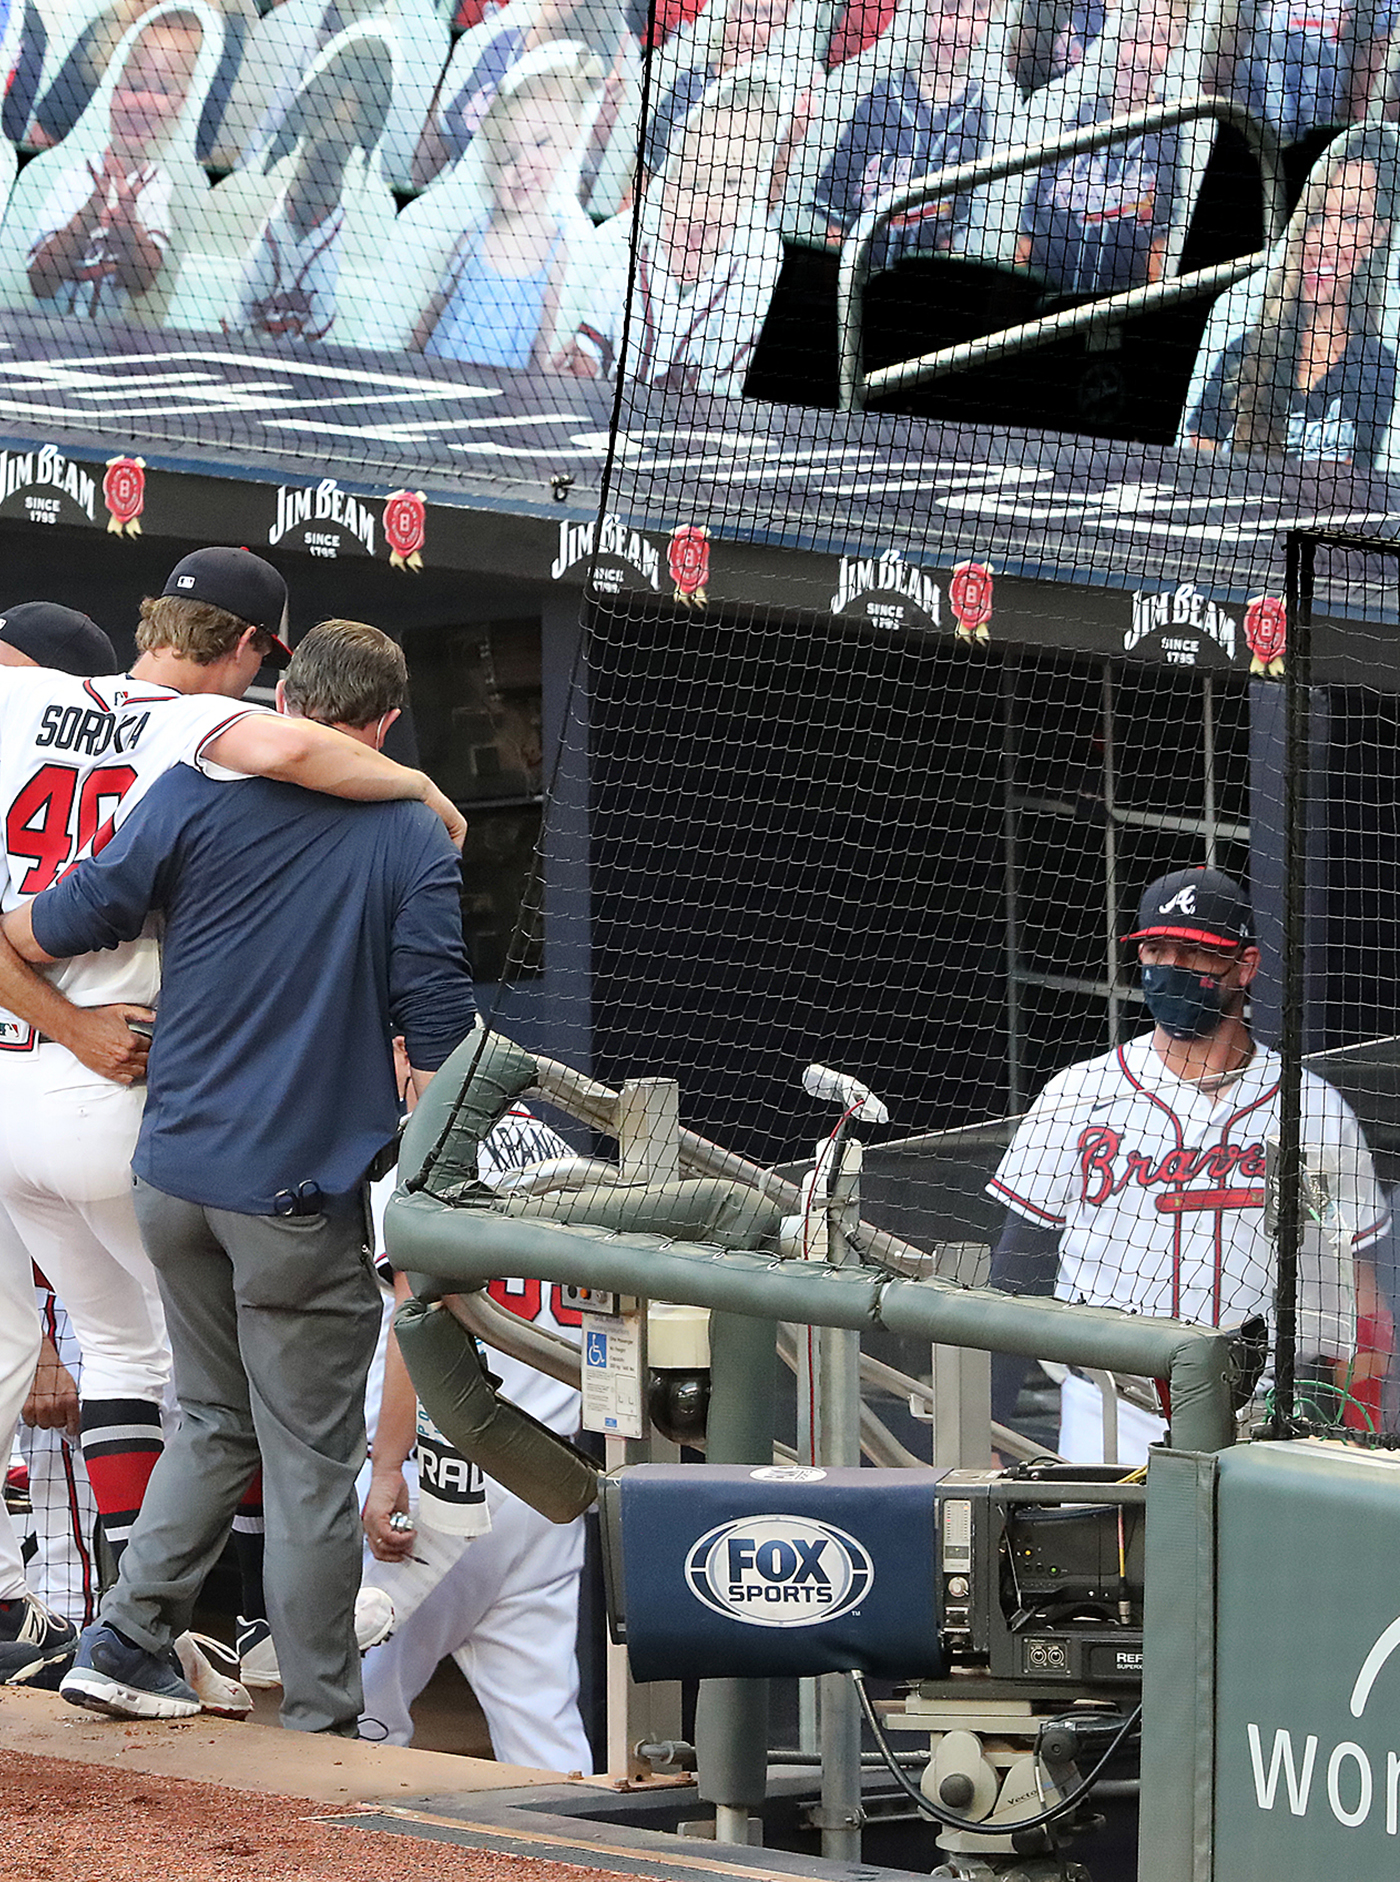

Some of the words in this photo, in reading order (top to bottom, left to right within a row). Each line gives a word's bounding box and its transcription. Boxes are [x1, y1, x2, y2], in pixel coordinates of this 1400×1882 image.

[35, 443, 96, 522] BEAM
[25, 496, 60, 512] SINCE
[30, 510, 57, 524] 1795
[269, 485, 313, 545] JIM
[314, 478, 375, 557] BEAM
[304, 532, 340, 547] SINCE
[309, 546, 338, 559] 1795
[551, 519, 596, 579] JIM
[598, 513, 659, 592] BEAM
[831, 555, 876, 614] JIM
[878, 549, 941, 627] BEAM
[866, 602, 904, 619] SINCE
[1123, 589, 1170, 651] JIM
[1171, 583, 1237, 661] BEAM
[1161, 637, 1199, 653] SINCE
[727, 1538, 831, 1584] FOX
[728, 1585, 833, 1603] SPORTS
[1007, 1789, 1038, 1805] Vecto
